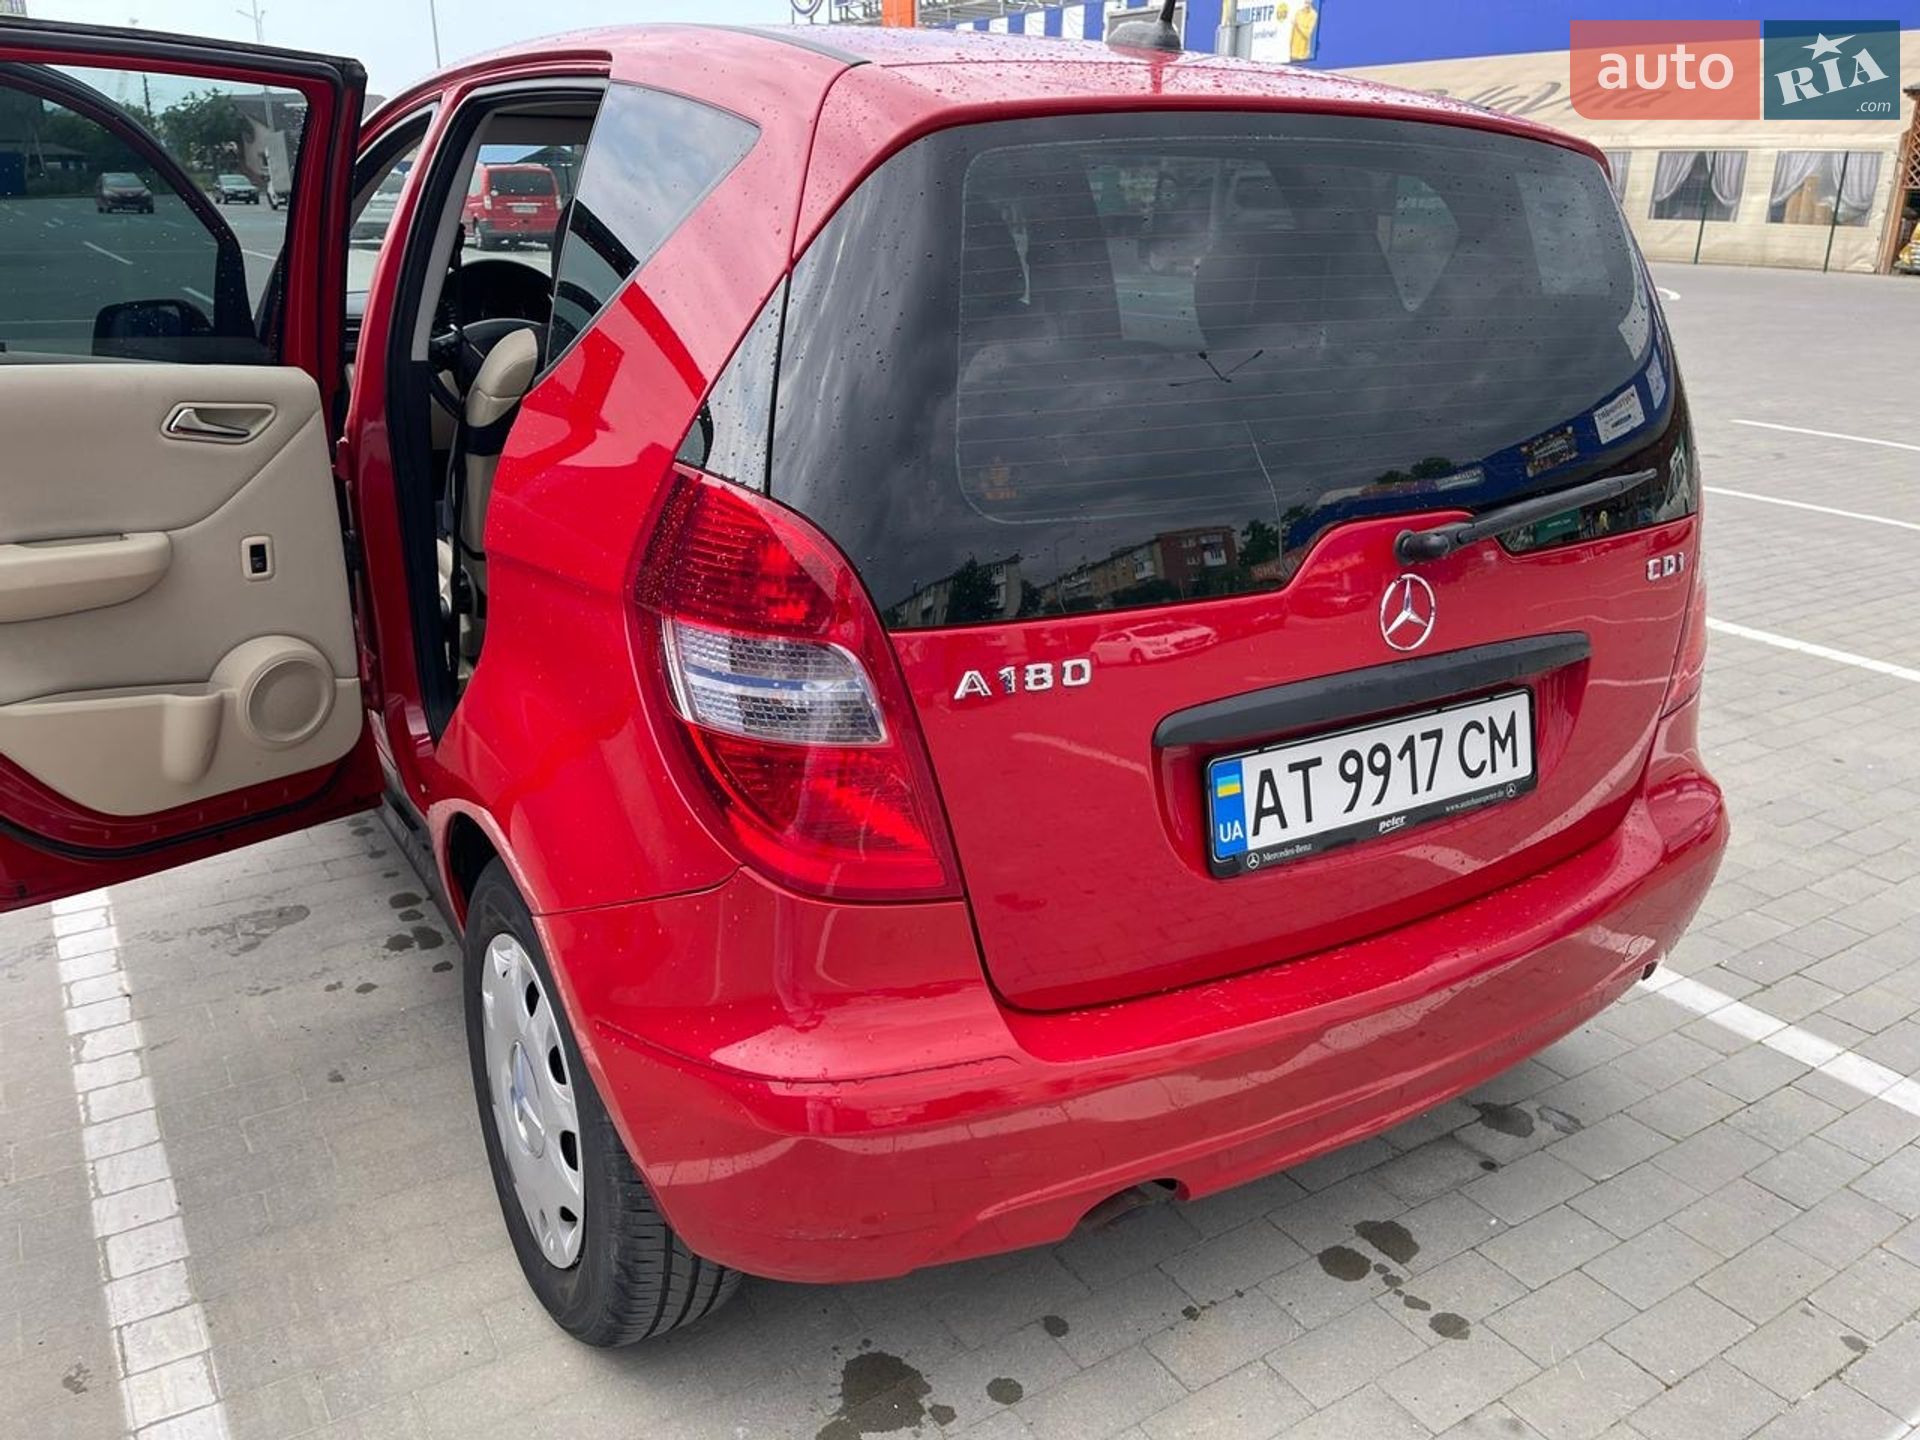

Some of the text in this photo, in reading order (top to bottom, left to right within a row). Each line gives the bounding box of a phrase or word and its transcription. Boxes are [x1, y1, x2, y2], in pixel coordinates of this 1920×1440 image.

[1647, 551, 1684, 581] CDI
[1252, 709, 1518, 837] AT 9917 CM
[1219, 820, 1244, 843] UA
[1262, 843, 1312, 862] Mercedes-Benz
